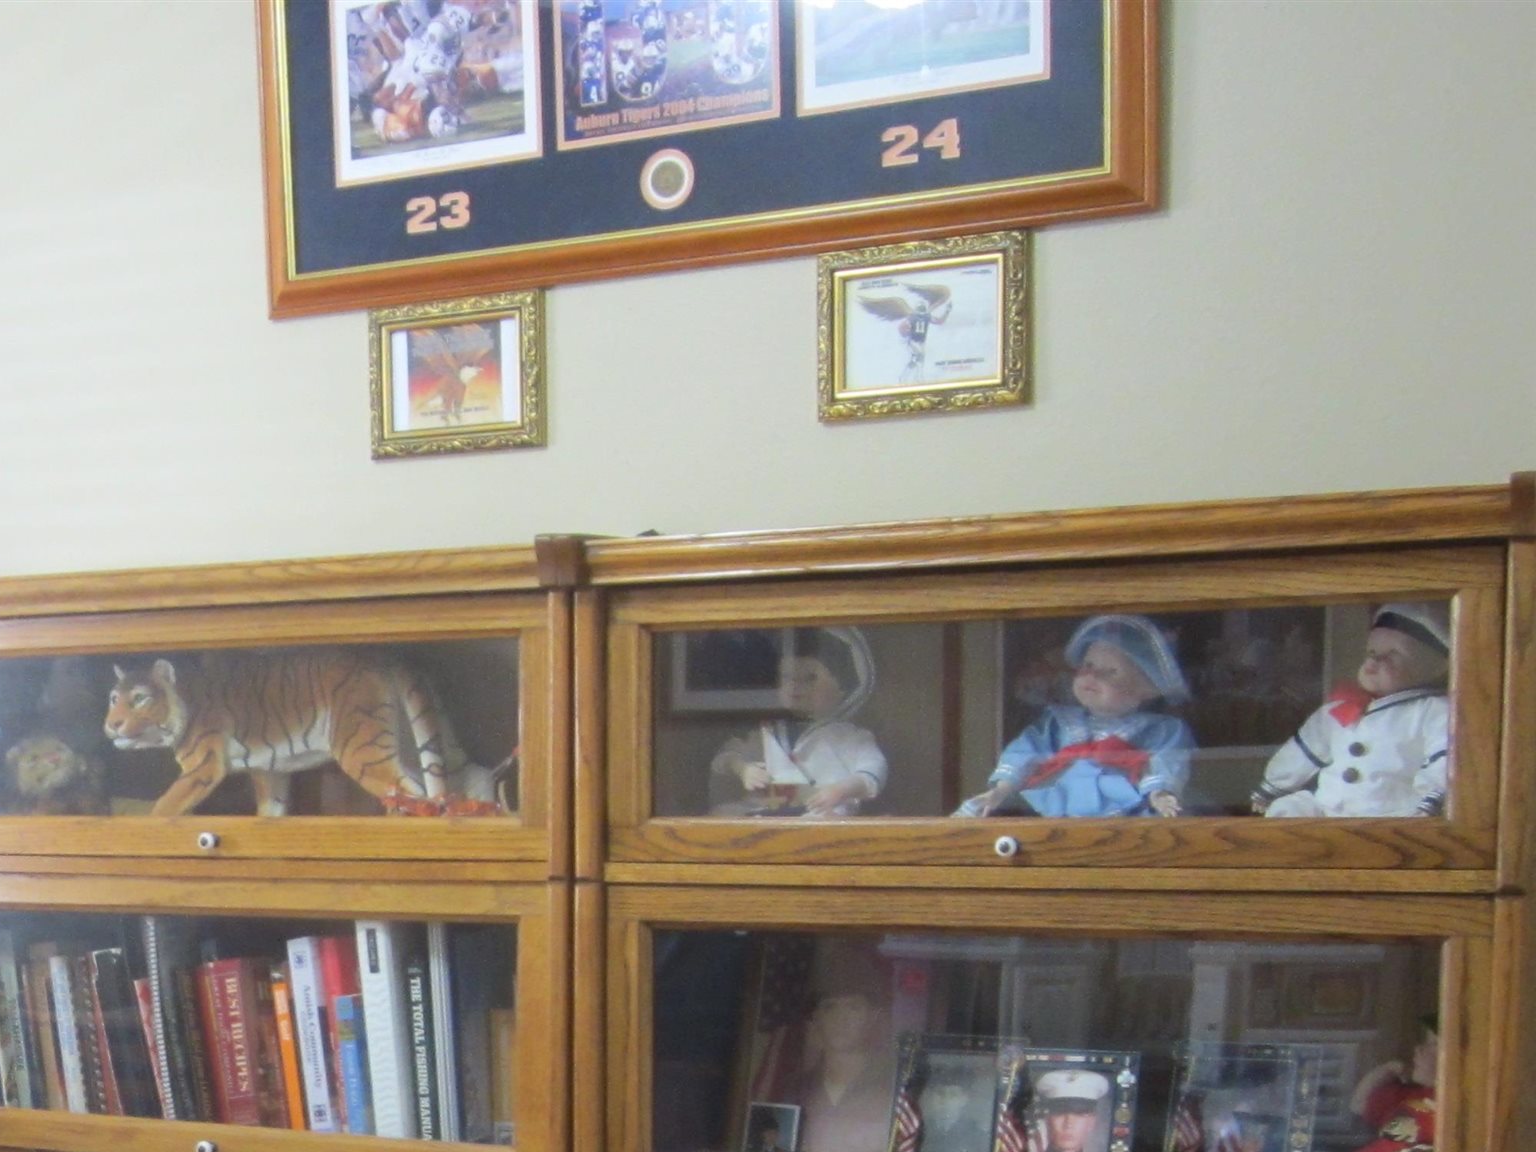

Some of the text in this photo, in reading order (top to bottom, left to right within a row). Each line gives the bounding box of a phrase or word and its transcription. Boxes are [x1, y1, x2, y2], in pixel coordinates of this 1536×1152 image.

[881, 118, 961, 168] 24
[405, 190, 471, 234] 23
[225, 977, 248, 1092] BEST RECIPES
[410, 976, 433, 1141] THE TOTAL FISHING MANUA
